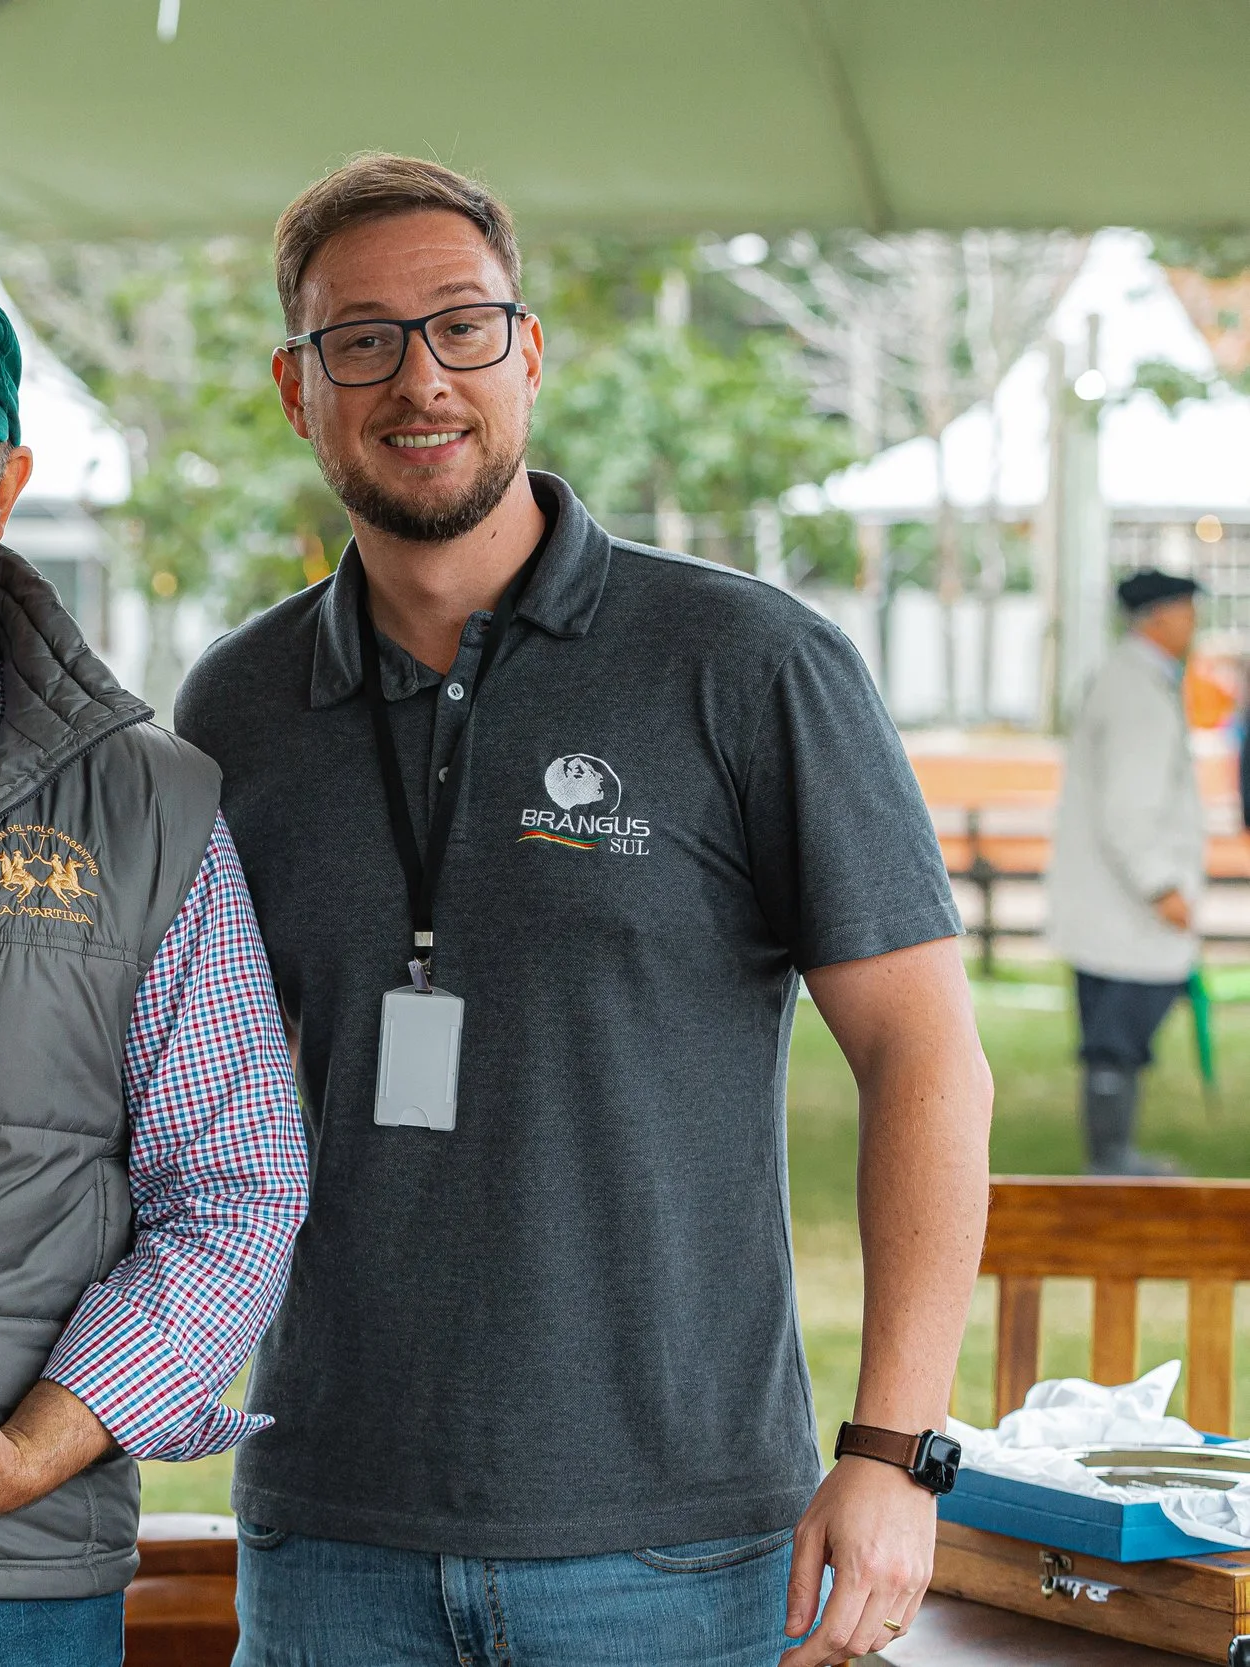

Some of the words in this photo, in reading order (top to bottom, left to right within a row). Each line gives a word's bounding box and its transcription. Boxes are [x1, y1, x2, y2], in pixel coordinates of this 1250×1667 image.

[521, 809, 650, 837] BRANGUS
[8, 824, 24, 833] DEL
[26, 825, 55, 835] POLO
[57, 831, 99, 876] ARGENTINO
[610, 838, 650, 855] SUL
[16, 907, 94, 925] MARTINA
